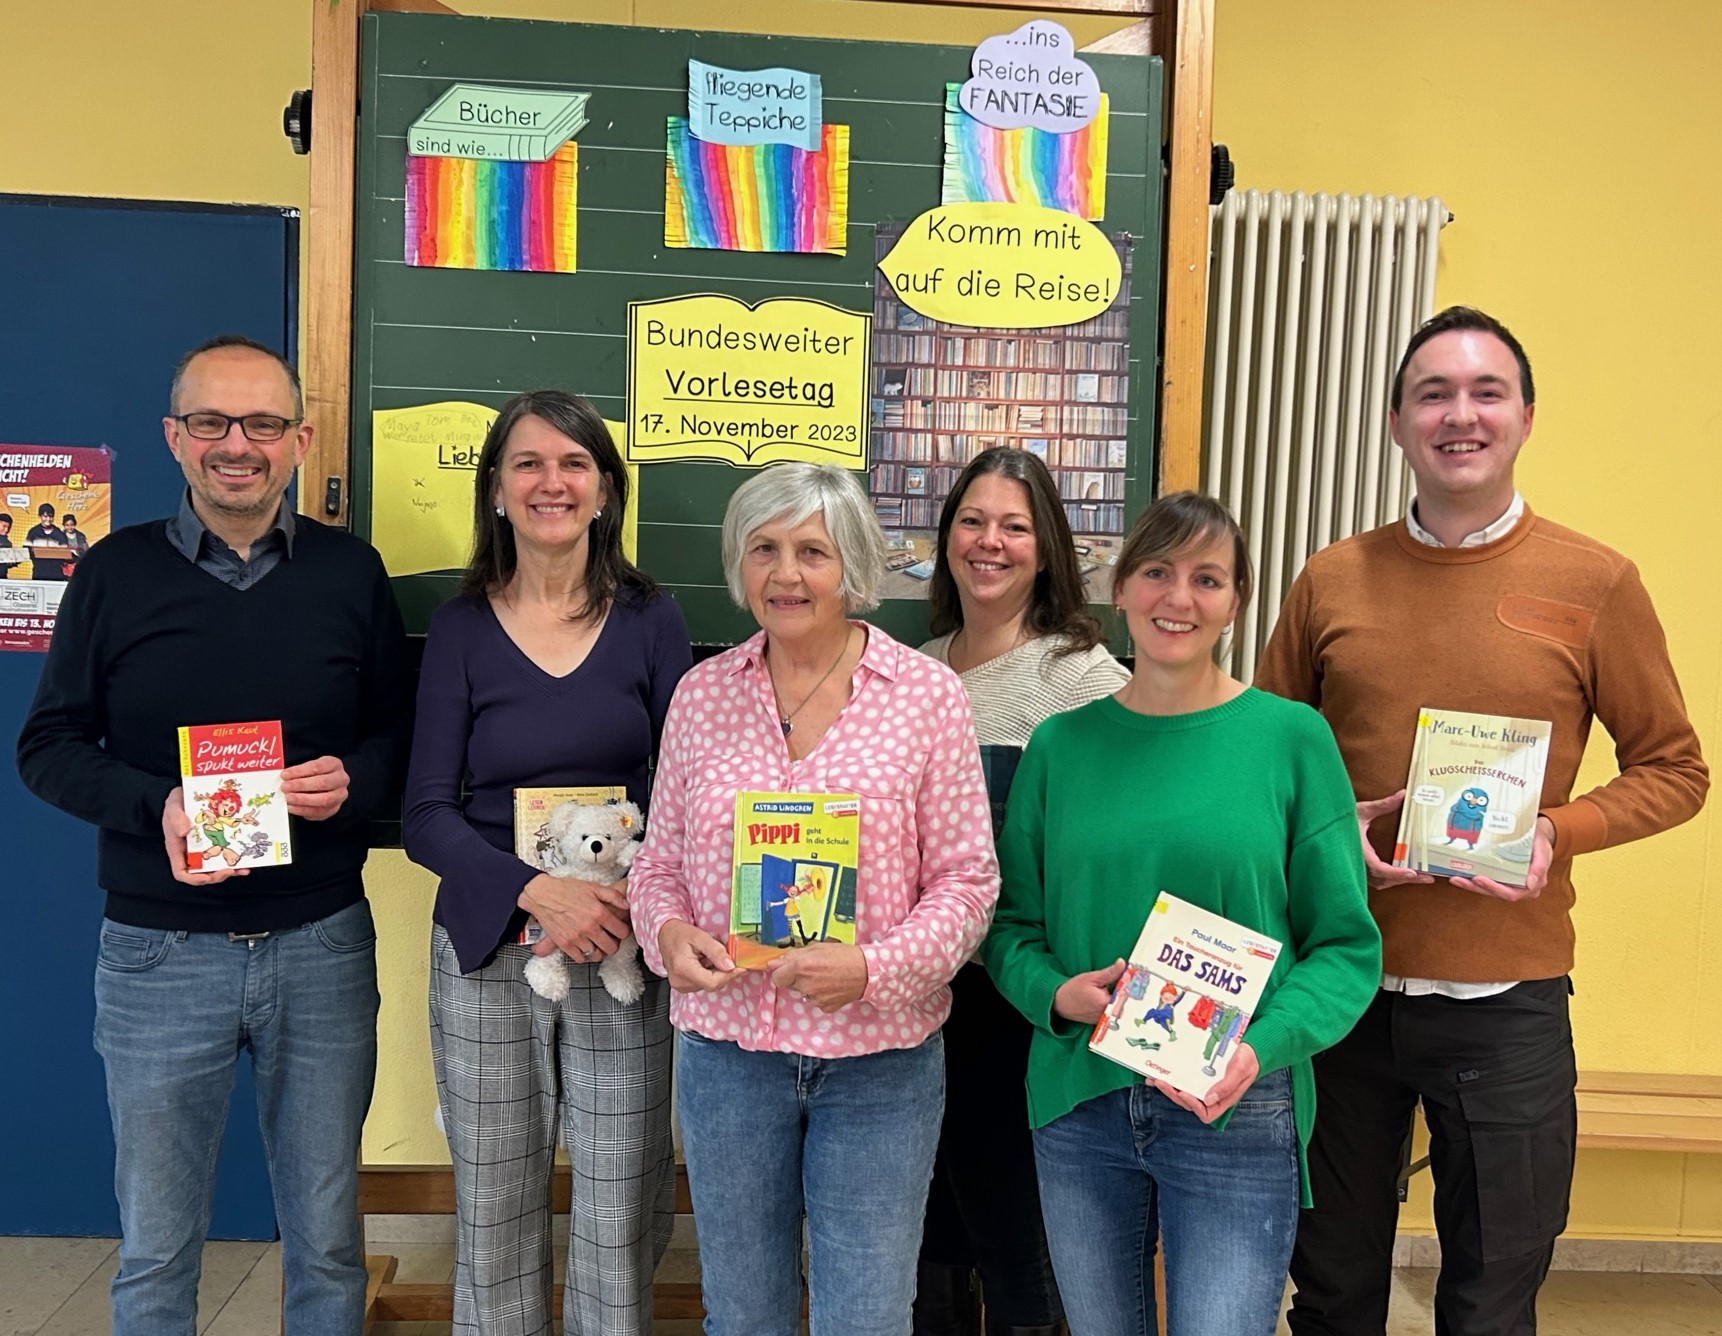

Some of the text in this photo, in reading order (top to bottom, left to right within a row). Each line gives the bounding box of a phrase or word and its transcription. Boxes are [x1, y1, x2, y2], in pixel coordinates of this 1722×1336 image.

[1005, 26, 1061, 48] ...ins
[978, 59, 1084, 87] Reich der
[705, 73, 806, 101] fliegende
[459, 101, 541, 127] Bücher
[969, 87, 1088, 119] FANTASIE
[705, 103, 807, 133] Teppiche
[416, 138, 503, 157] sind wie...
[928, 215, 1082, 250] Komm mit
[895, 268, 1110, 304] auf die Reise!
[647, 319, 854, 356] Bundesweiter
[665, 368, 834, 408] Vorlesetag
[640, 413, 857, 442] 17. November 2023
[0, 454, 72, 469] CHENHELDEN
[0, 469, 29, 483] ICHT!
[4, 591, 36, 601] ZECH
[43, 619, 56, 629] NO
[213, 725, 259, 738] Ellis Kaut
[1432, 720, 1538, 747] Marc-Uwe Kling
[197, 736, 276, 758] Pumuckl
[196, 754, 281, 774] spukt weiter
[1429, 766, 1526, 788] KLUGSCHEISSERCHEN
[747, 822, 801, 846] Pippi
[806, 827, 822, 836] geht
[814, 837, 825, 845] die
[826, 837, 850, 846] Schule
[1172, 936, 1185, 946] Ein
[1191, 928, 1237, 953] Paul Maar
[1157, 943, 1248, 995] DAS SAMS
